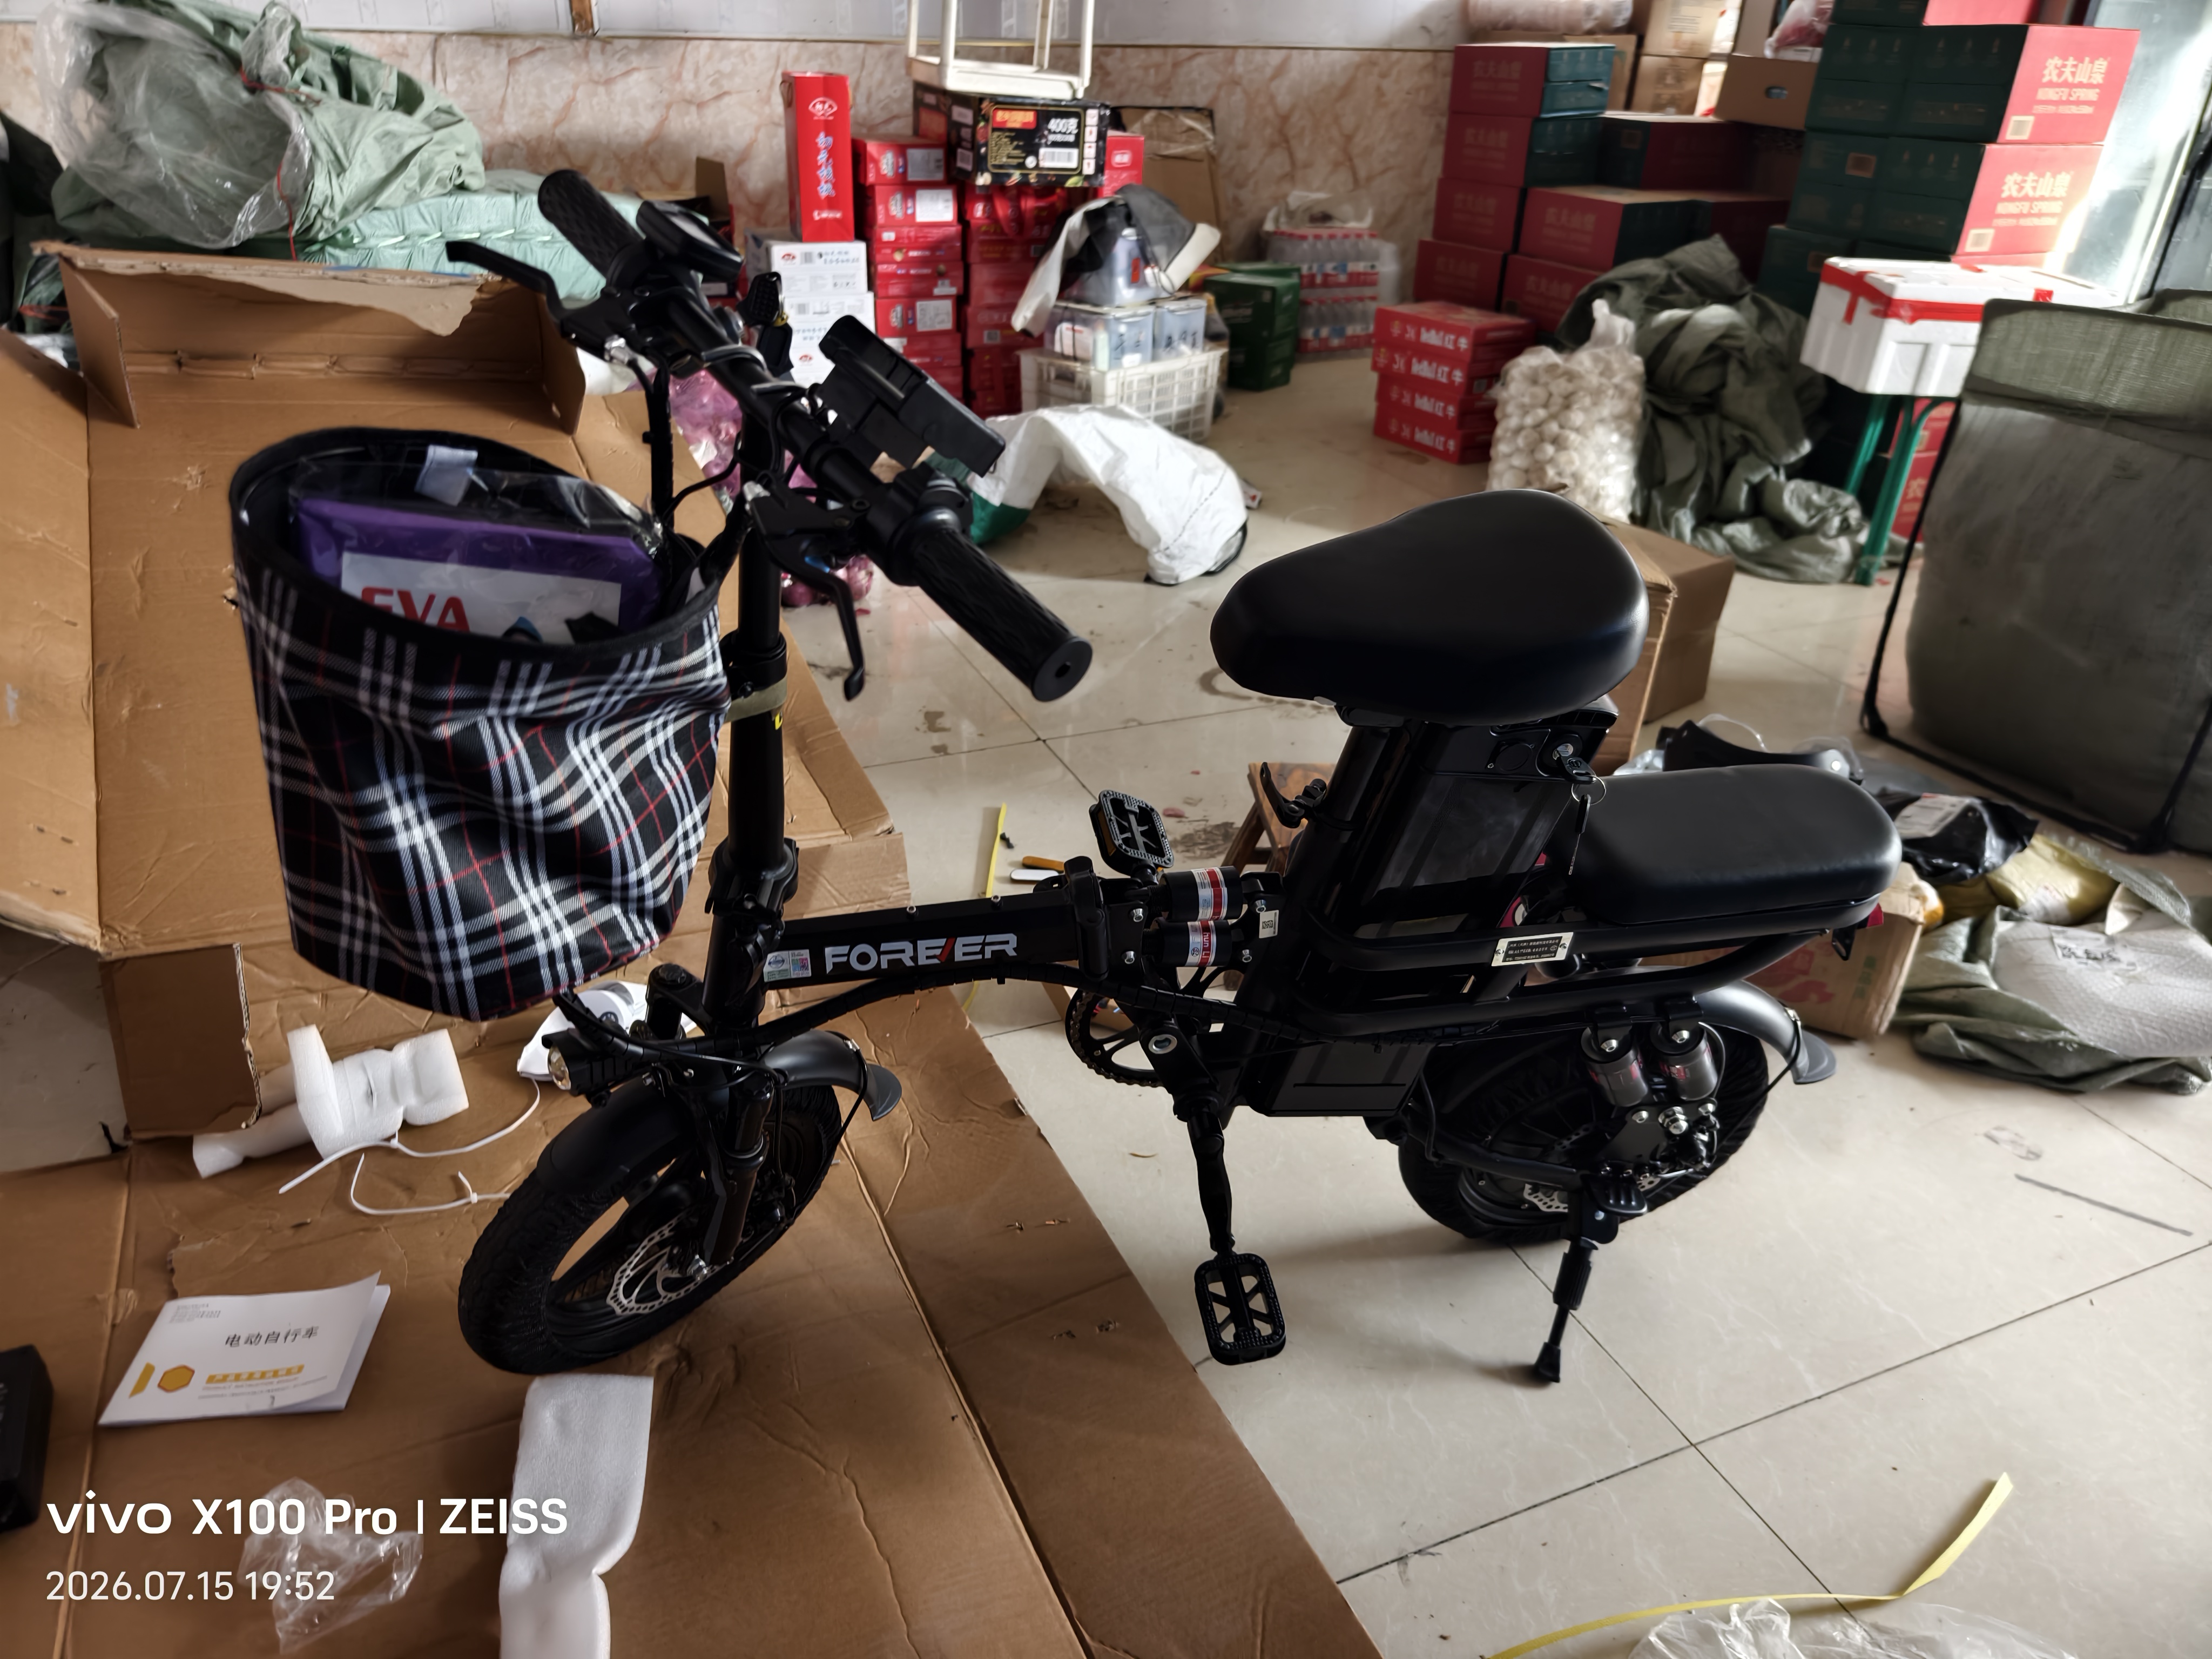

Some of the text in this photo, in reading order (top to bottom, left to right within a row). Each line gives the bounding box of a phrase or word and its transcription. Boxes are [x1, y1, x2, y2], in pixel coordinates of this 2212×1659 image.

[2041, 56, 2108, 84] 农夫山泉
[1048, 118, 1079, 134] 400克
[2000, 171, 2071, 198] 农夫山泉
[825, 933, 1017, 974] FOREVER
[225, 1326, 319, 1347] 电动自行车
